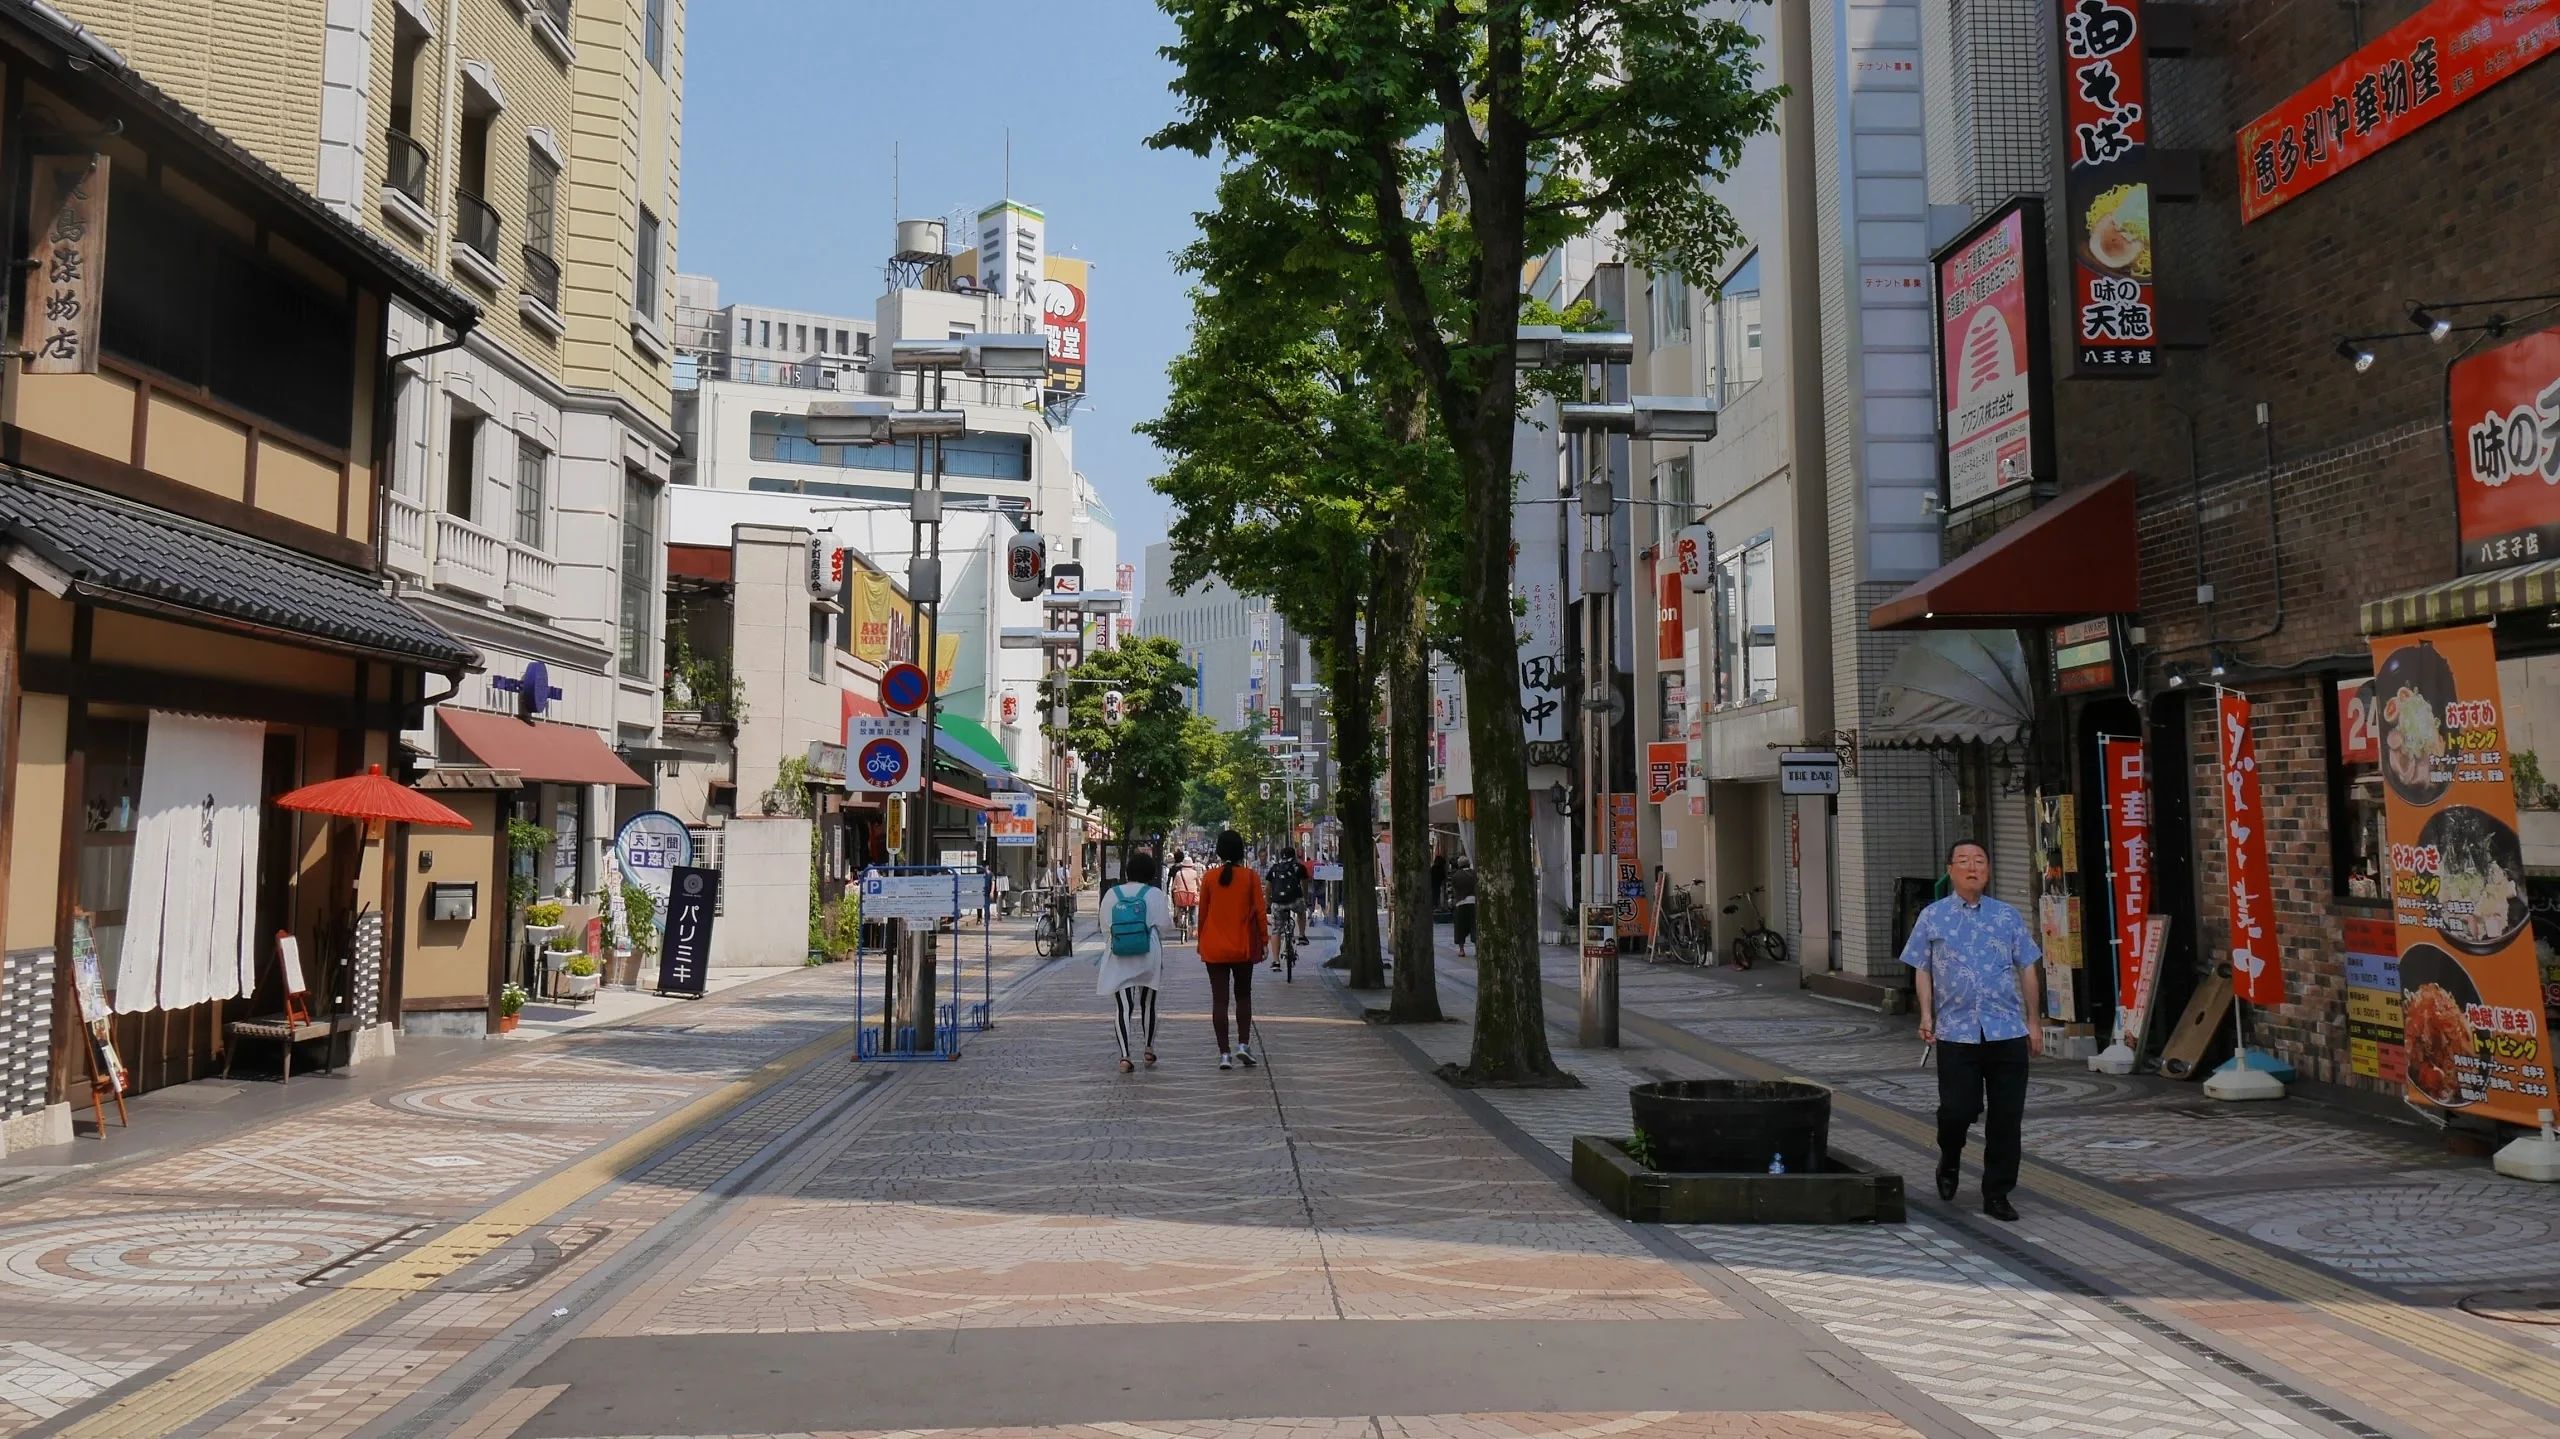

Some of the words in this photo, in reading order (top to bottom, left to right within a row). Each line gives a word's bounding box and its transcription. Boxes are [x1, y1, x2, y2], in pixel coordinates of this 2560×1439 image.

[1857, 62, 1912, 71] テナント募集
[2068, 0, 2140, 162] 油そば
[39, 165, 88, 360] 島染物店
[1864, 277, 1922, 288] テナント募集
[2092, 278, 2138, 302] 味の
[2084, 304, 2152, 338] 天徳
[2084, 350, 2152, 364] 八王子店
[2481, 534, 2539, 562] 八王子店
[859, 622, 888, 636] ABC
[860, 635, 888, 646] MART
[1106, 693, 1119, 720] 中町
[2446, 701, 2495, 728] おすすめ
[2447, 728, 2497, 750] トッピング
[2392, 844, 2440, 873] やみつき
[2396, 873, 2440, 897] トッピング
[672, 904, 700, 984] パリミキ
[2473, 1032, 2537, 1060] トッピング
